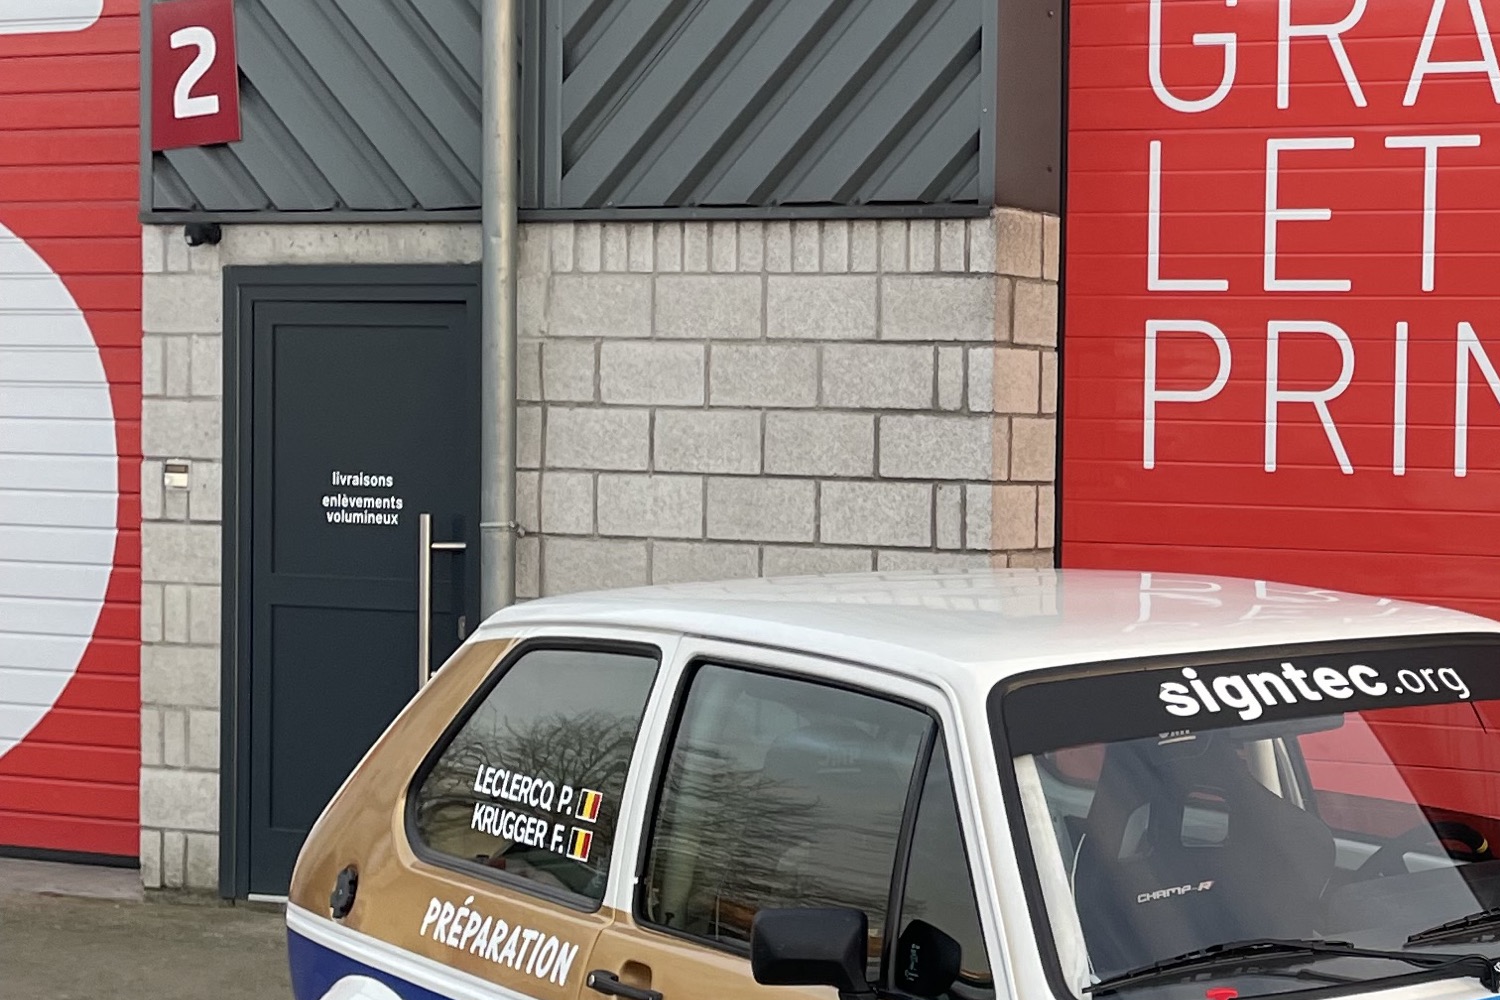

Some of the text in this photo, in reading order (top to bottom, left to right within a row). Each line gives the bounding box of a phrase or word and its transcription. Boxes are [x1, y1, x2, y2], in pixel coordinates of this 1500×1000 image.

[170, 26, 219, 118] 2
[322, 493, 403, 510] enlèvements
[332, 471, 393, 487] livraisons
[326, 509, 399, 525] volumineux
[1159, 662, 1471, 721] signtec.org
[474, 764, 573, 815] LECLERCQ P.
[471, 802, 565, 854] KRUGGER F.
[420, 896, 579, 986] PRÉPARATION
